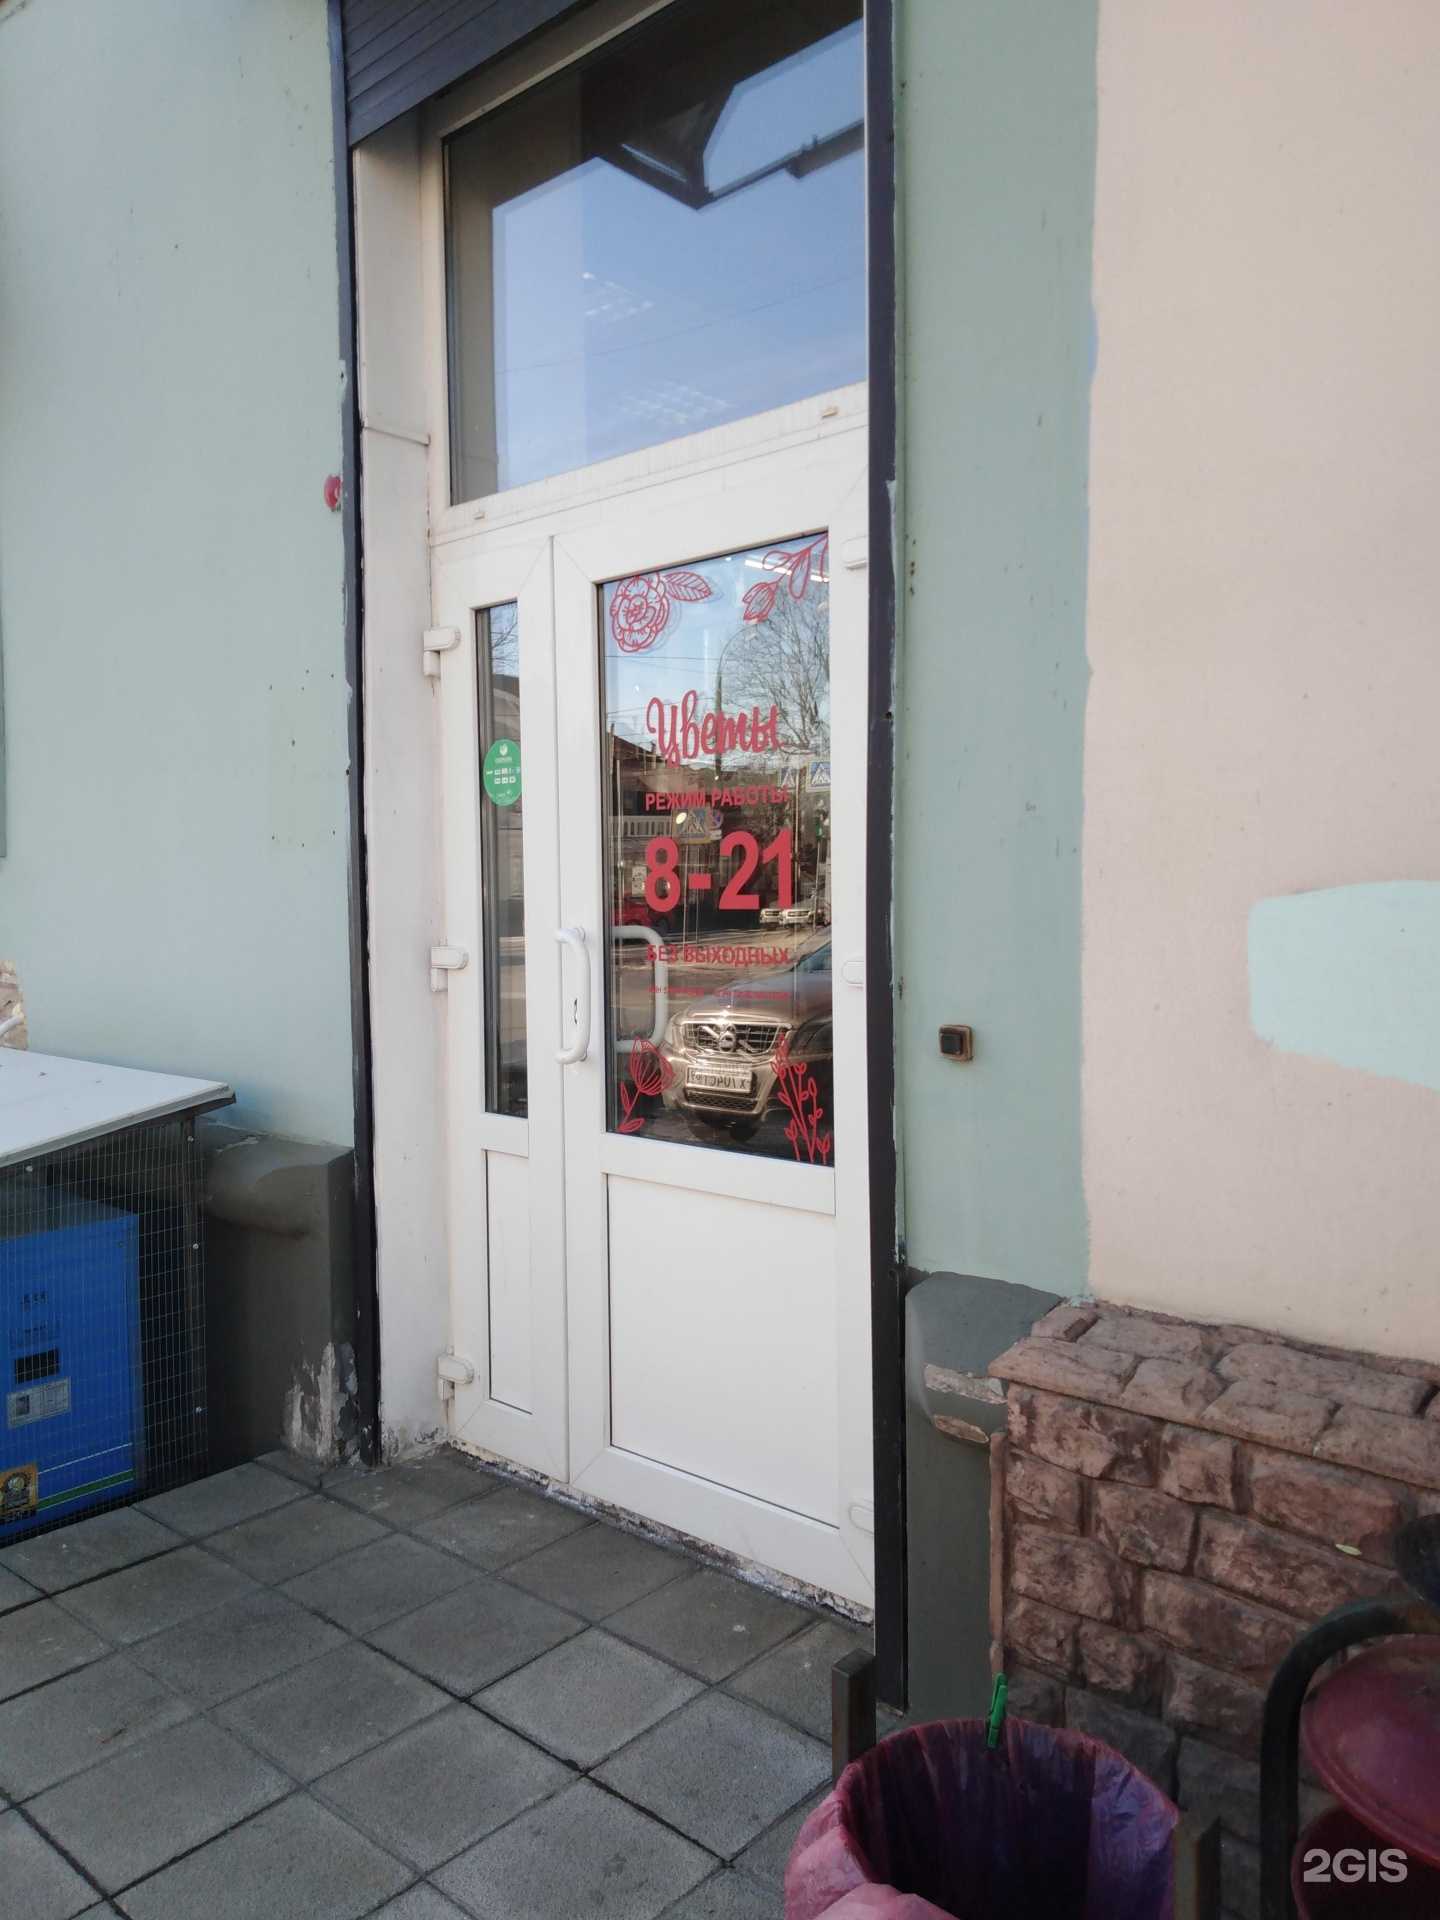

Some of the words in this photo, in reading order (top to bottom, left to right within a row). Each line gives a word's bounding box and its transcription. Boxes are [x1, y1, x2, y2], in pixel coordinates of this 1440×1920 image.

[646, 690, 781, 768] Цветы
[646, 788, 706, 811] РЕЖИМ
[711, 785, 790, 806] РАБОТЫ
[647, 944, 678, 963] БЕЗ
[684, 944, 790, 967] ВЫХОДНЫХ
